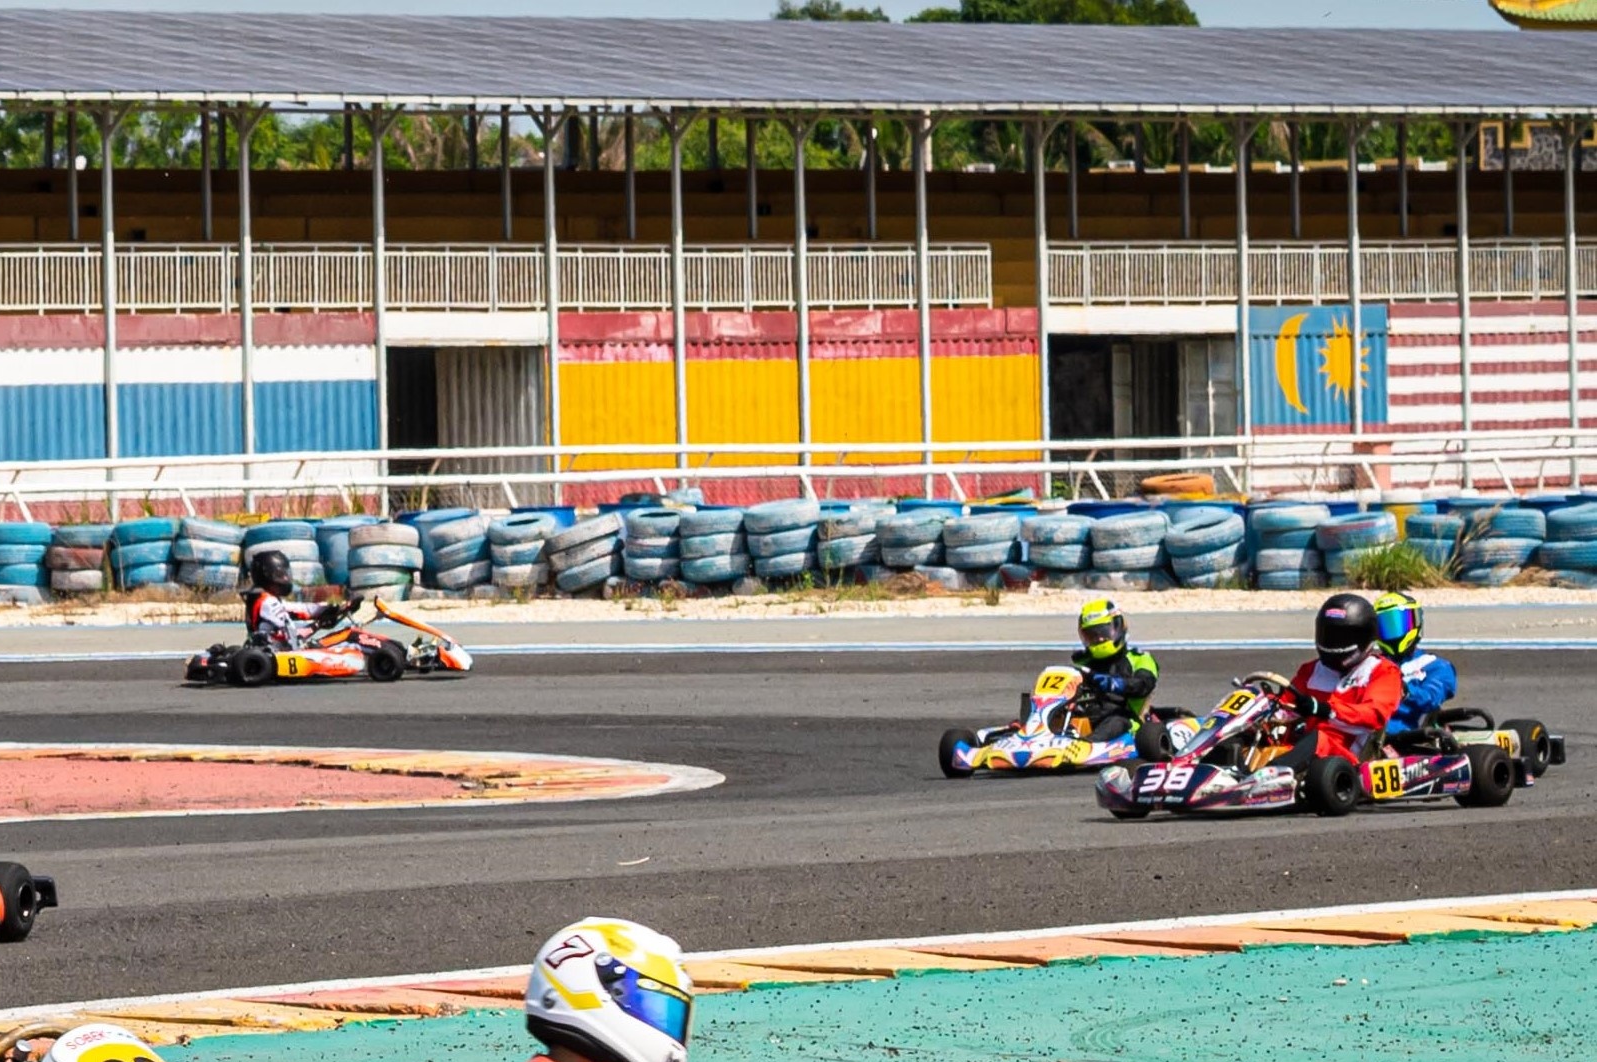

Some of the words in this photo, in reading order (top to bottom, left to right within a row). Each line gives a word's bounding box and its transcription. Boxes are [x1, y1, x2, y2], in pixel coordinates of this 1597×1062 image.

[1041, 675, 1065, 690] 12
[1139, 767, 1194, 793] 38
[1372, 764, 1400, 794] 38
[545, 934, 595, 970] 7
